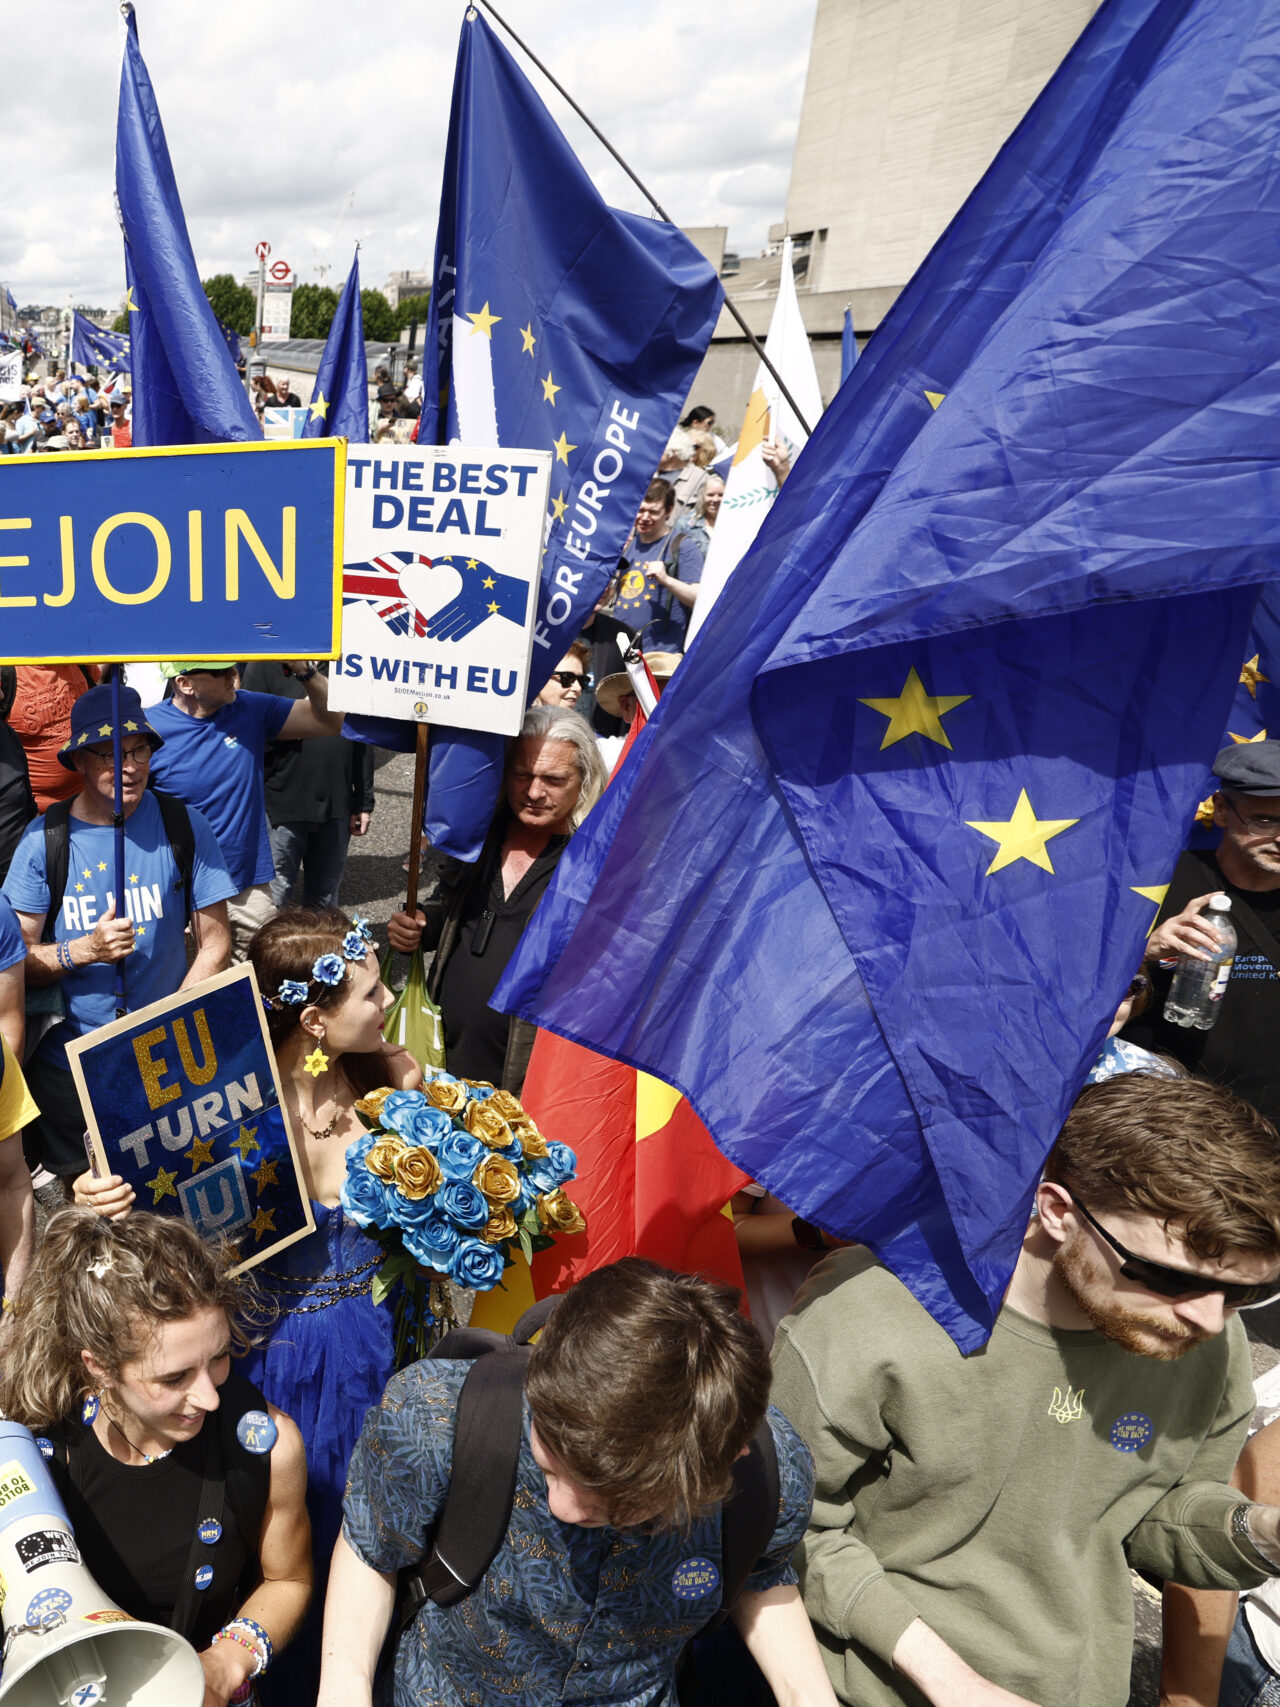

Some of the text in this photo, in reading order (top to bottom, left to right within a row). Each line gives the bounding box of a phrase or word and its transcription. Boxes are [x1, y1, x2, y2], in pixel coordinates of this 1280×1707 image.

[257, 243, 270, 257] N
[347, 459, 538, 496] THE BEST
[372, 494, 501, 537] DEAL
[532, 399, 640, 650] FOR EUROPE
[335, 653, 518, 697] IS WITH EU
[1230, 971, 1266, 979] United
[1234, 955, 1269, 963] Europ
[131, 1007, 218, 1111] EU
[119, 1072, 263, 1169] TURN
[11, 1475, 26, 1486] TO
[201, 1529, 218, 1539] NRM
